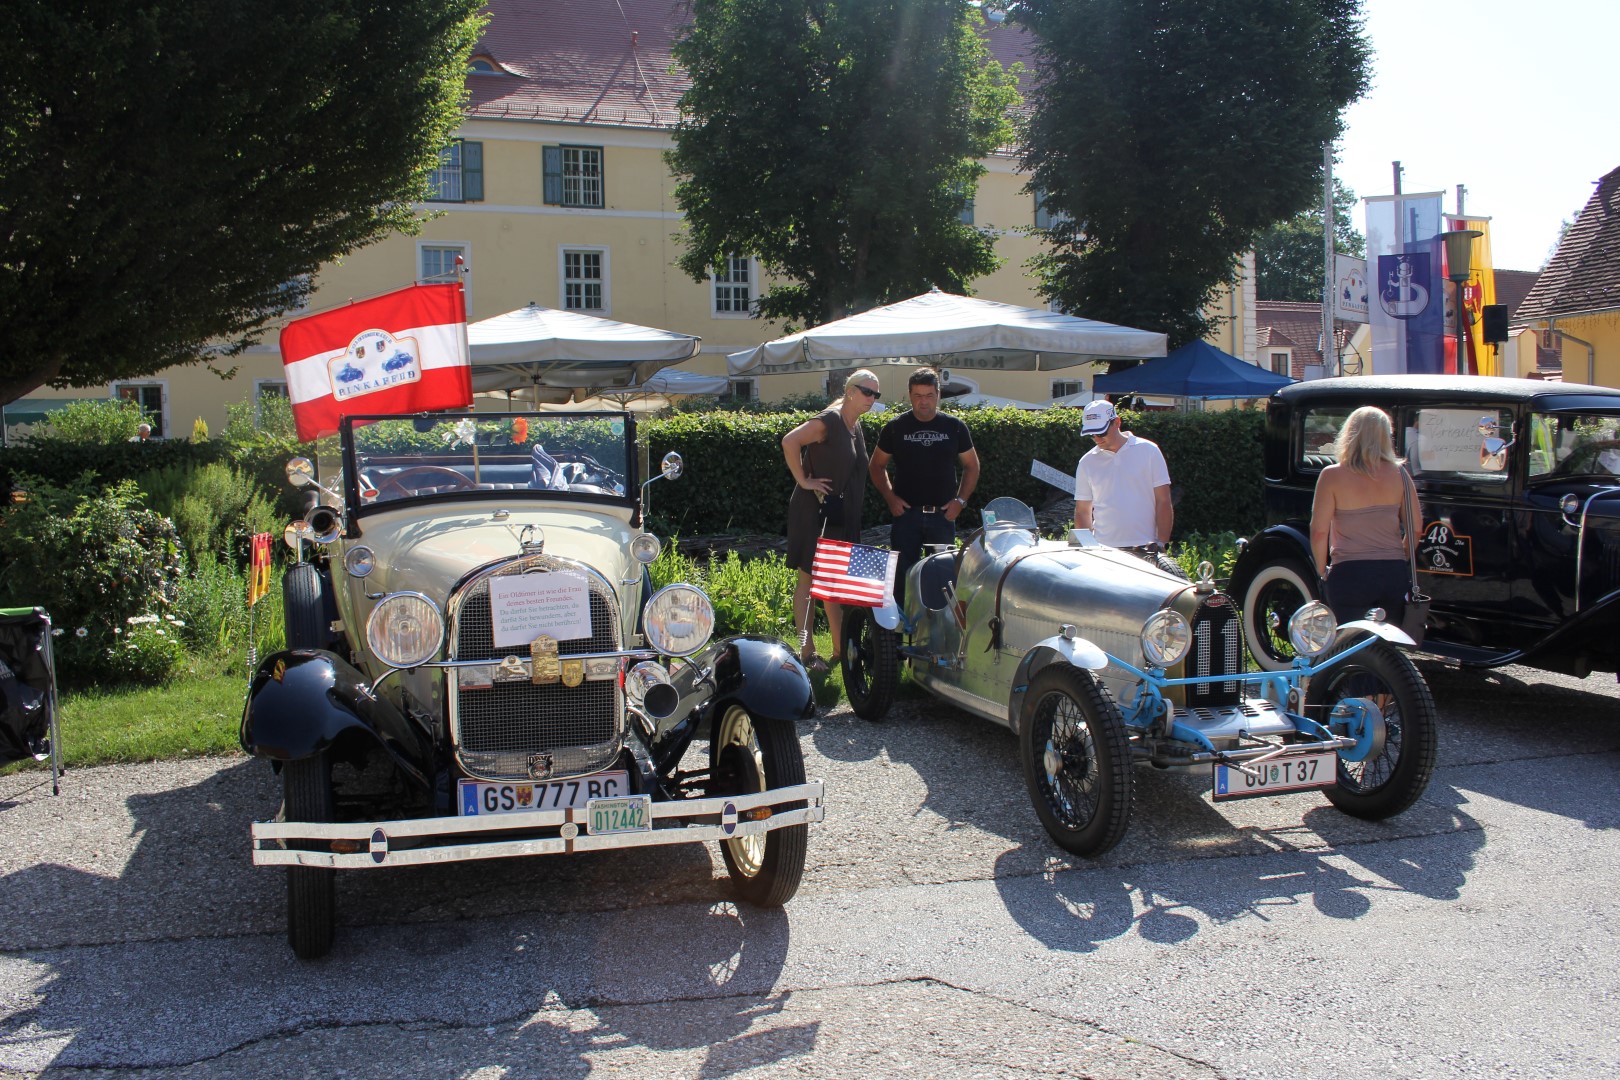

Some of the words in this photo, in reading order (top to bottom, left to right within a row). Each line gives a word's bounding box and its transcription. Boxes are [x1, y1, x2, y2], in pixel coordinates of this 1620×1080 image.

[1427, 526, 1448, 544] 48
[510, 591, 536, 599] Oldtimer
[558, 586, 567, 594] die
[1282, 762, 1292, 783] T
[1297, 759, 1319, 781] 37
[467, 805, 475, 813] A
[483, 786, 515, 812] GS
[534, 781, 580, 808] 777
[595, 808, 644, 831] 012442
